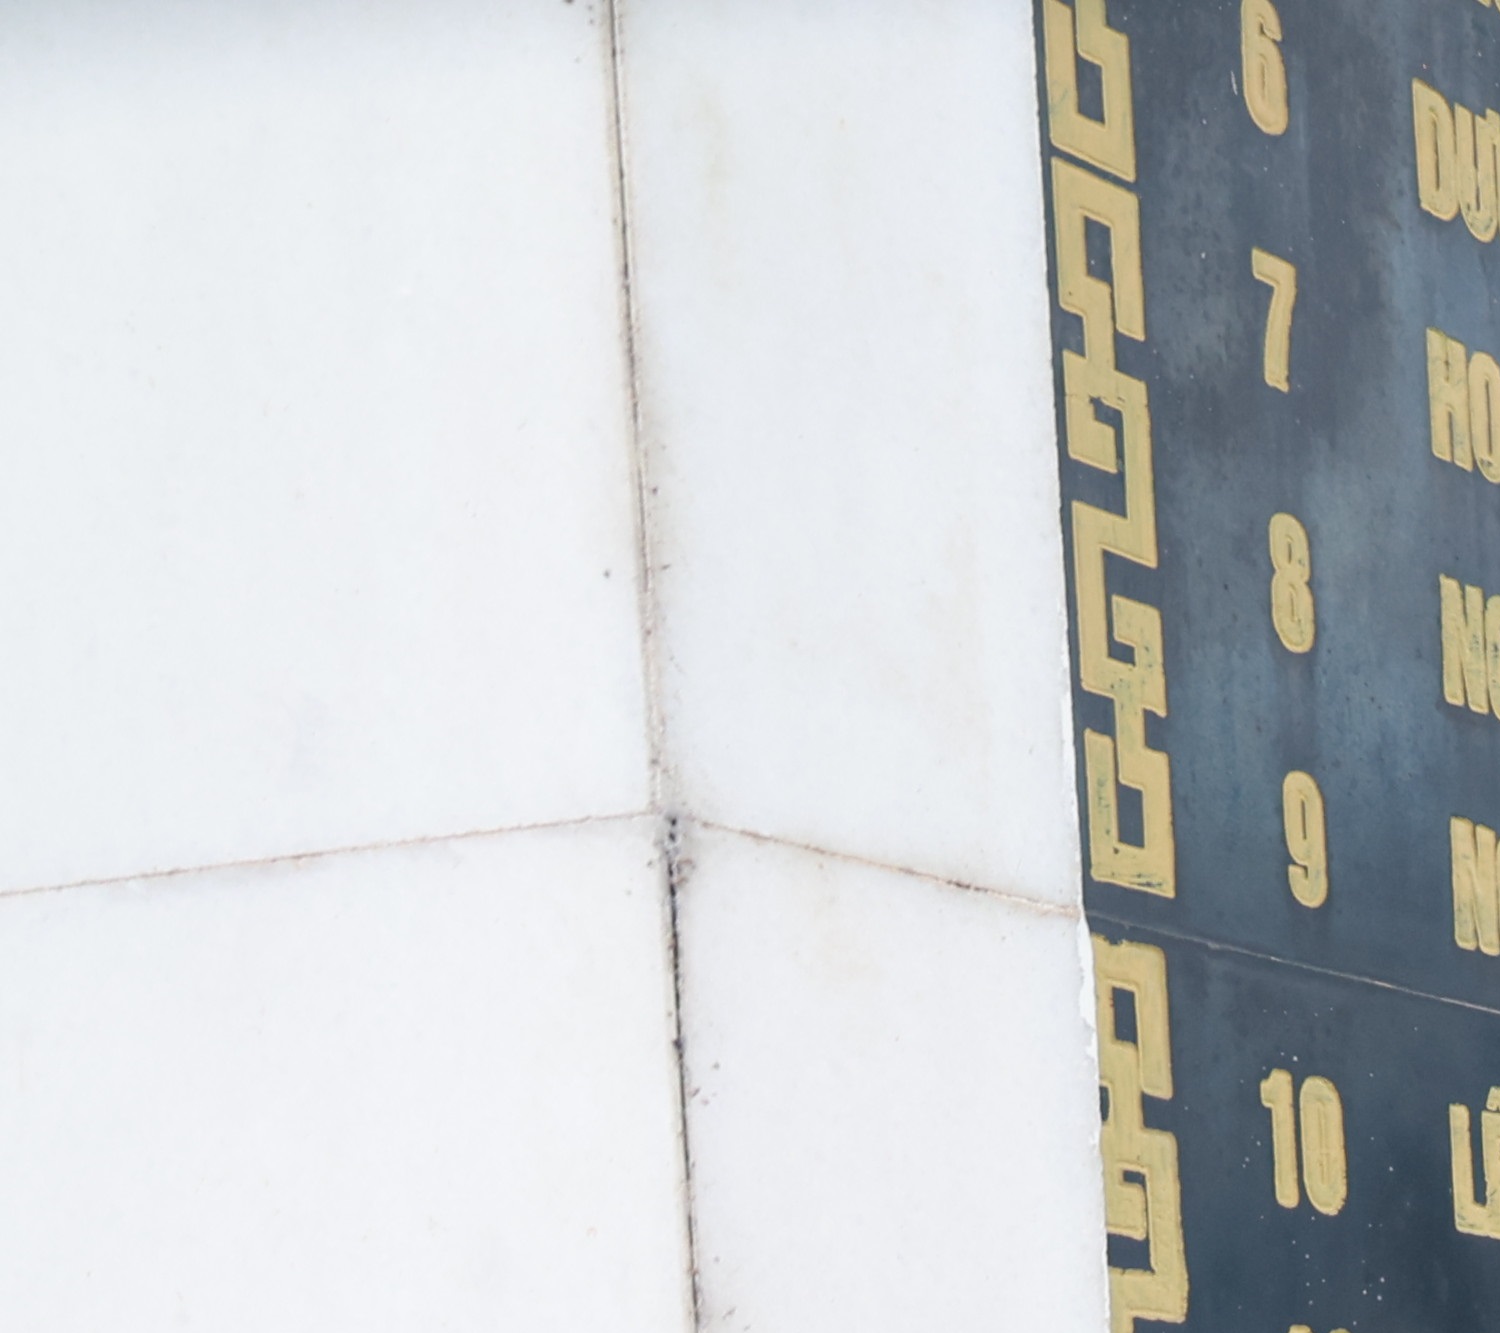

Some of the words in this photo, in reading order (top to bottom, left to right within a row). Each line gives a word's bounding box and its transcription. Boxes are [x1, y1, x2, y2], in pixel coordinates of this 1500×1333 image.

[1242, 0, 1288, 135] 6
[1252, 248, 1296, 391] 7
[1269, 513, 1315, 653] 8
[1283, 770, 1328, 908] 9
[1260, 1068, 1348, 1215] 10
